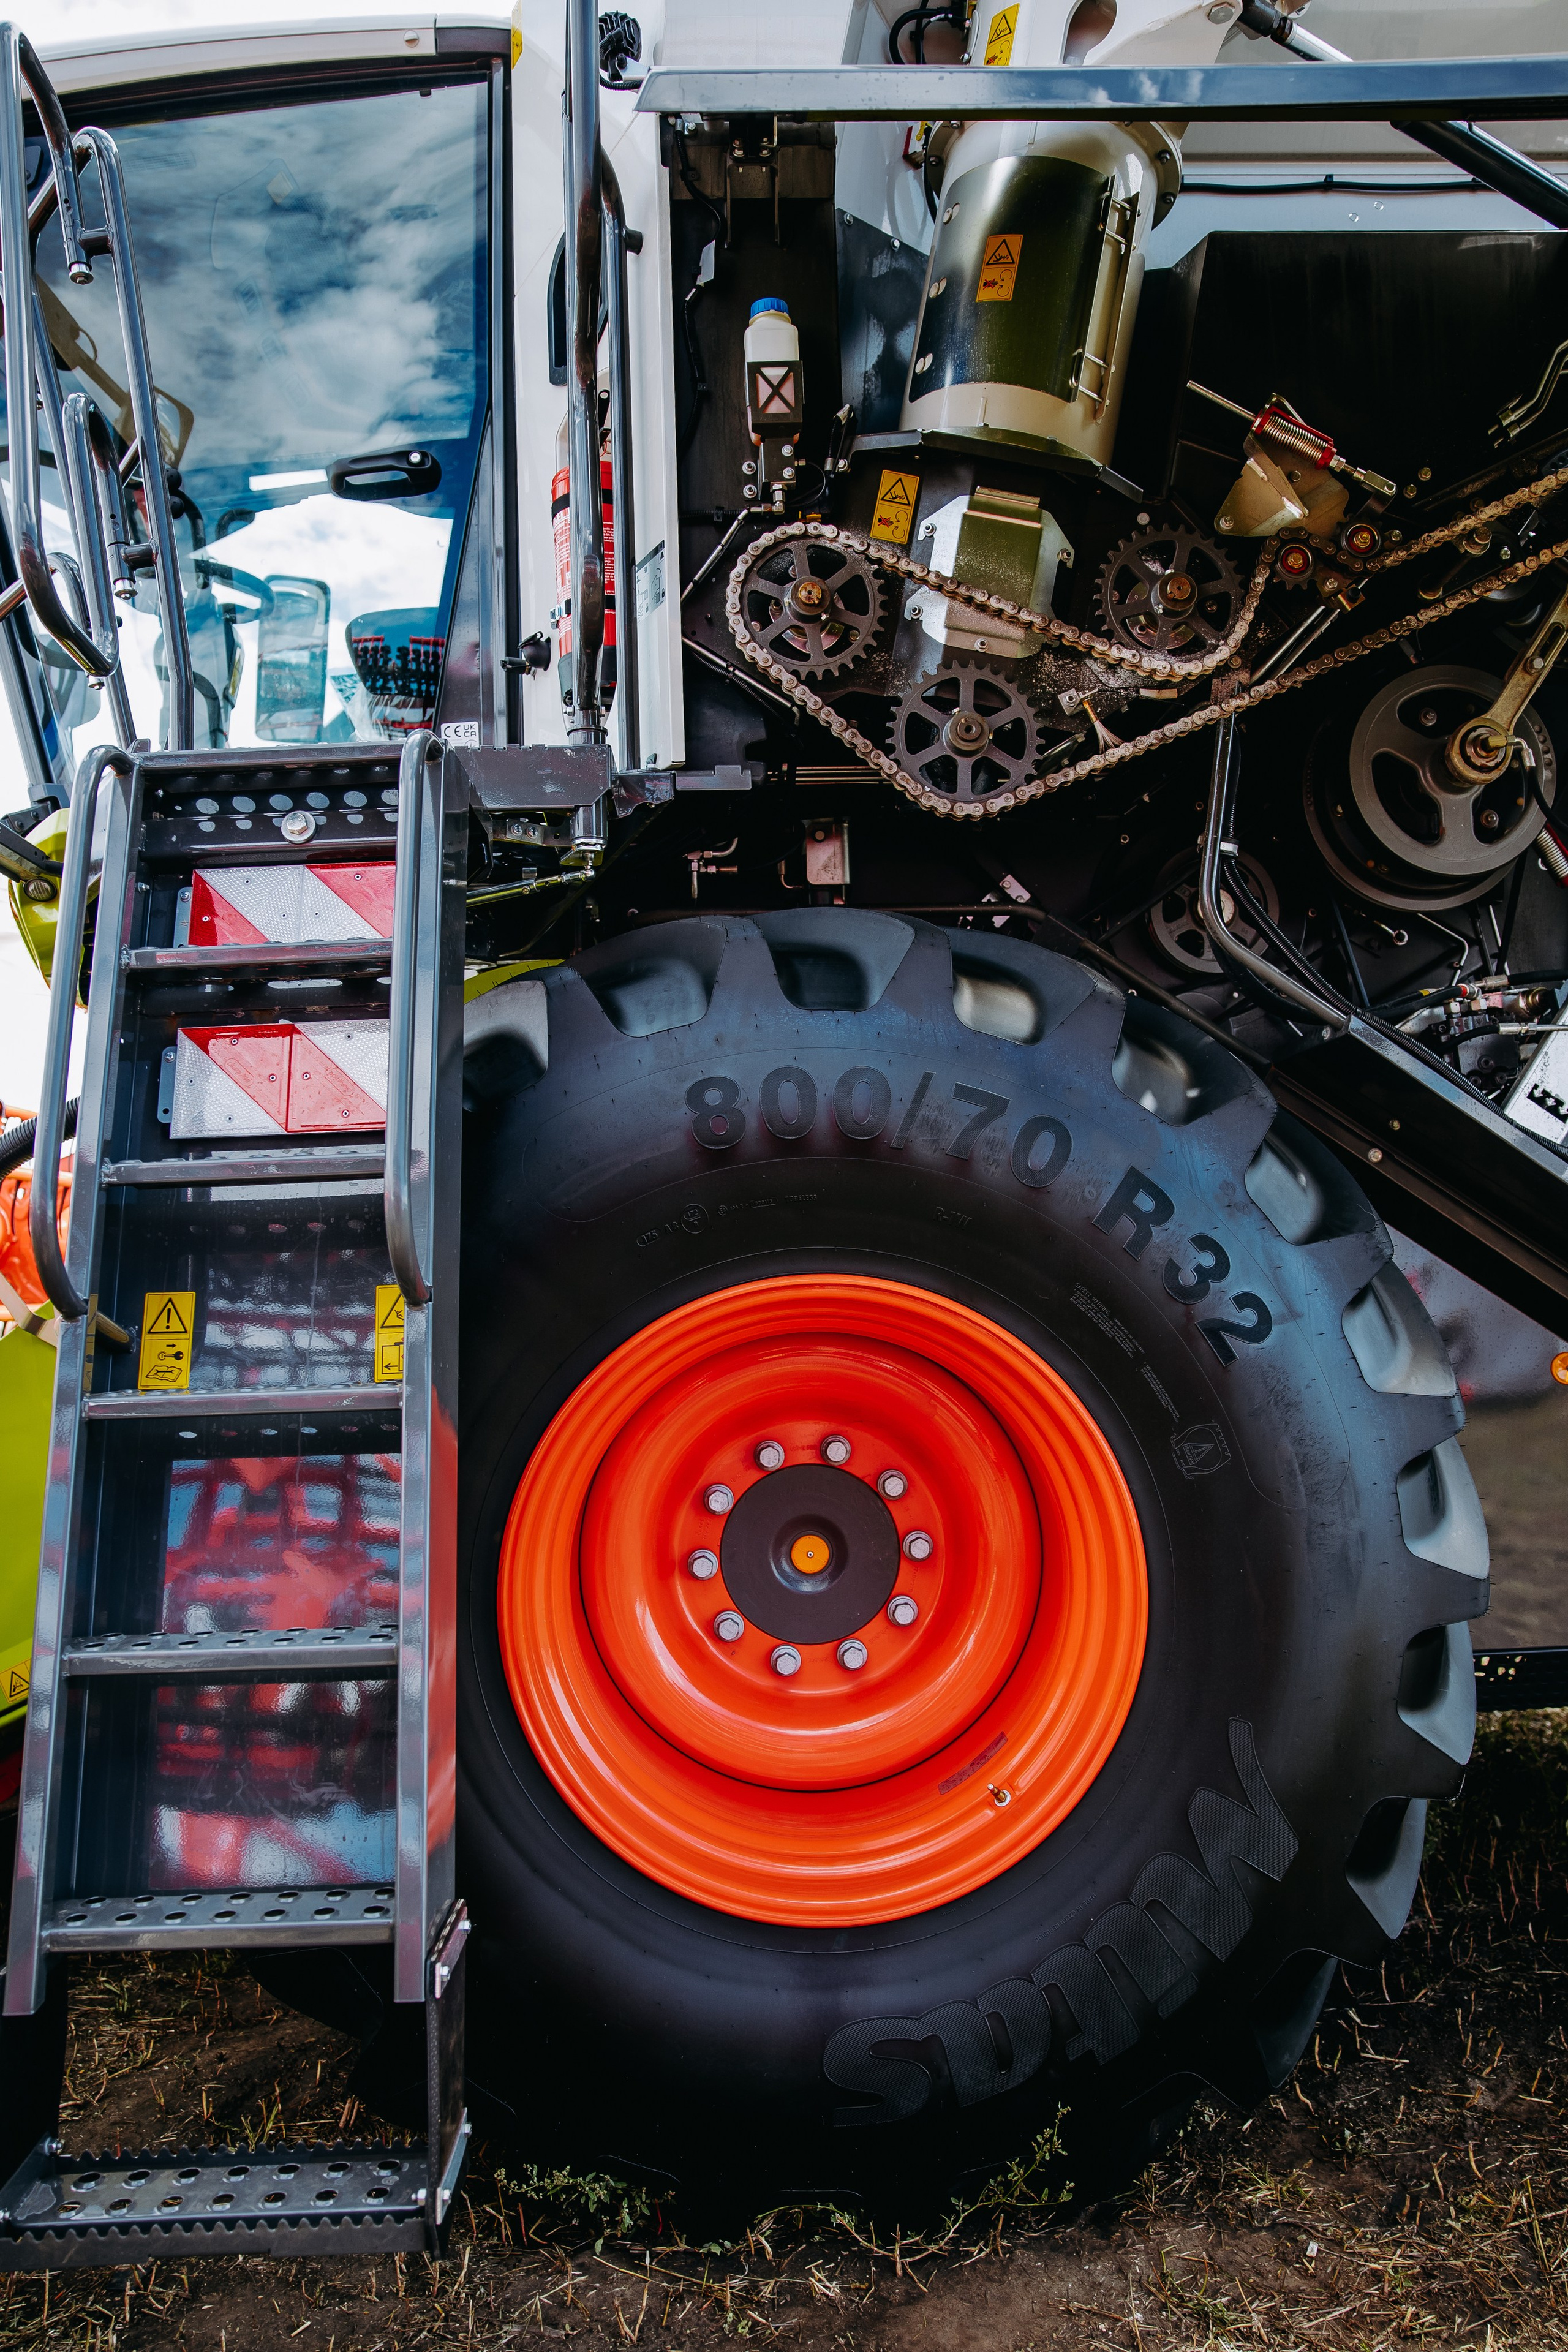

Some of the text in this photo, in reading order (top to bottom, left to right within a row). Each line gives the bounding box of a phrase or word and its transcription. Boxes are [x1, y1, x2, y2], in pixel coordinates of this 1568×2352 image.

[444, 725, 461, 738] CE
[684, 1065, 1074, 1188] 800/70
[785, 1194, 818, 1203] TUBELESS
[1074, 1282, 1092, 1298] SAFETY
[1033, 1893, 1096, 1944] MADE IN CZECH REPUBLIC
